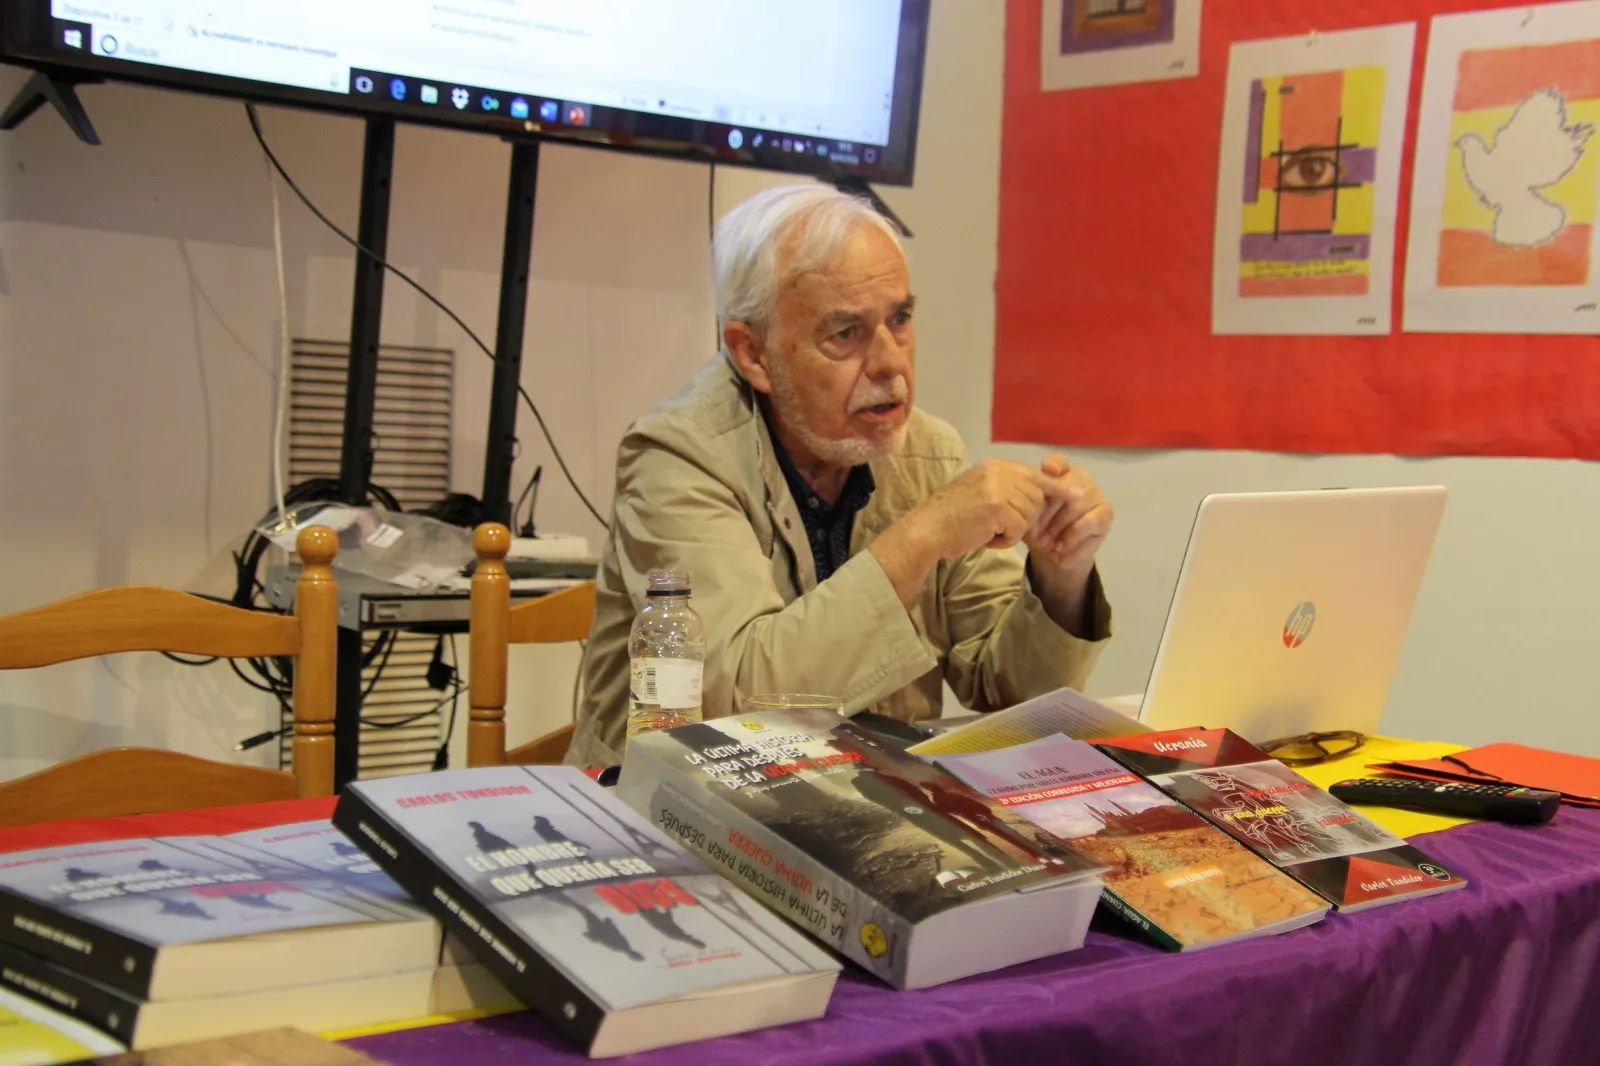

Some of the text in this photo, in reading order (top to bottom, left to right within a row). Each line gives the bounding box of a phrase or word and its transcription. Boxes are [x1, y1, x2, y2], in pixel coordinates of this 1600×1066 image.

[1285, 603, 1314, 648] hp
[684, 731, 816, 766] LA ÚLTIMA HISTORIA
[1153, 736, 1208, 753] Ucrania
[701, 744, 806, 779] PARA DESPUÉS
[722, 776, 749, 791] DE
[748, 769, 768, 784] LA
[1016, 770, 1037, 781] EL
[1009, 791, 1043, 804] EDICIÓN
[1041, 784, 1087, 799] CORREGIDA
[1092, 776, 1137, 790] MEJORADA
[464, 840, 587, 873] EL HOMBRE
[728, 827, 773, 867] GUERRA
[490, 857, 656, 896] QUE QUERÍA SER
[658, 809, 844, 941] LA ÚLTIMA HISTORIA PARA DESPUÉS
[956, 880, 988, 893] Carlos
[982, 870, 1025, 885] Tundidor
[1360, 874, 1423, 892] Carlos Tundidor
[815, 885, 830, 907] LA
[830, 897, 848, 920] DE
[1122, 905, 1143, 924] AGUA:
[1141, 919, 1151, 931] EL
